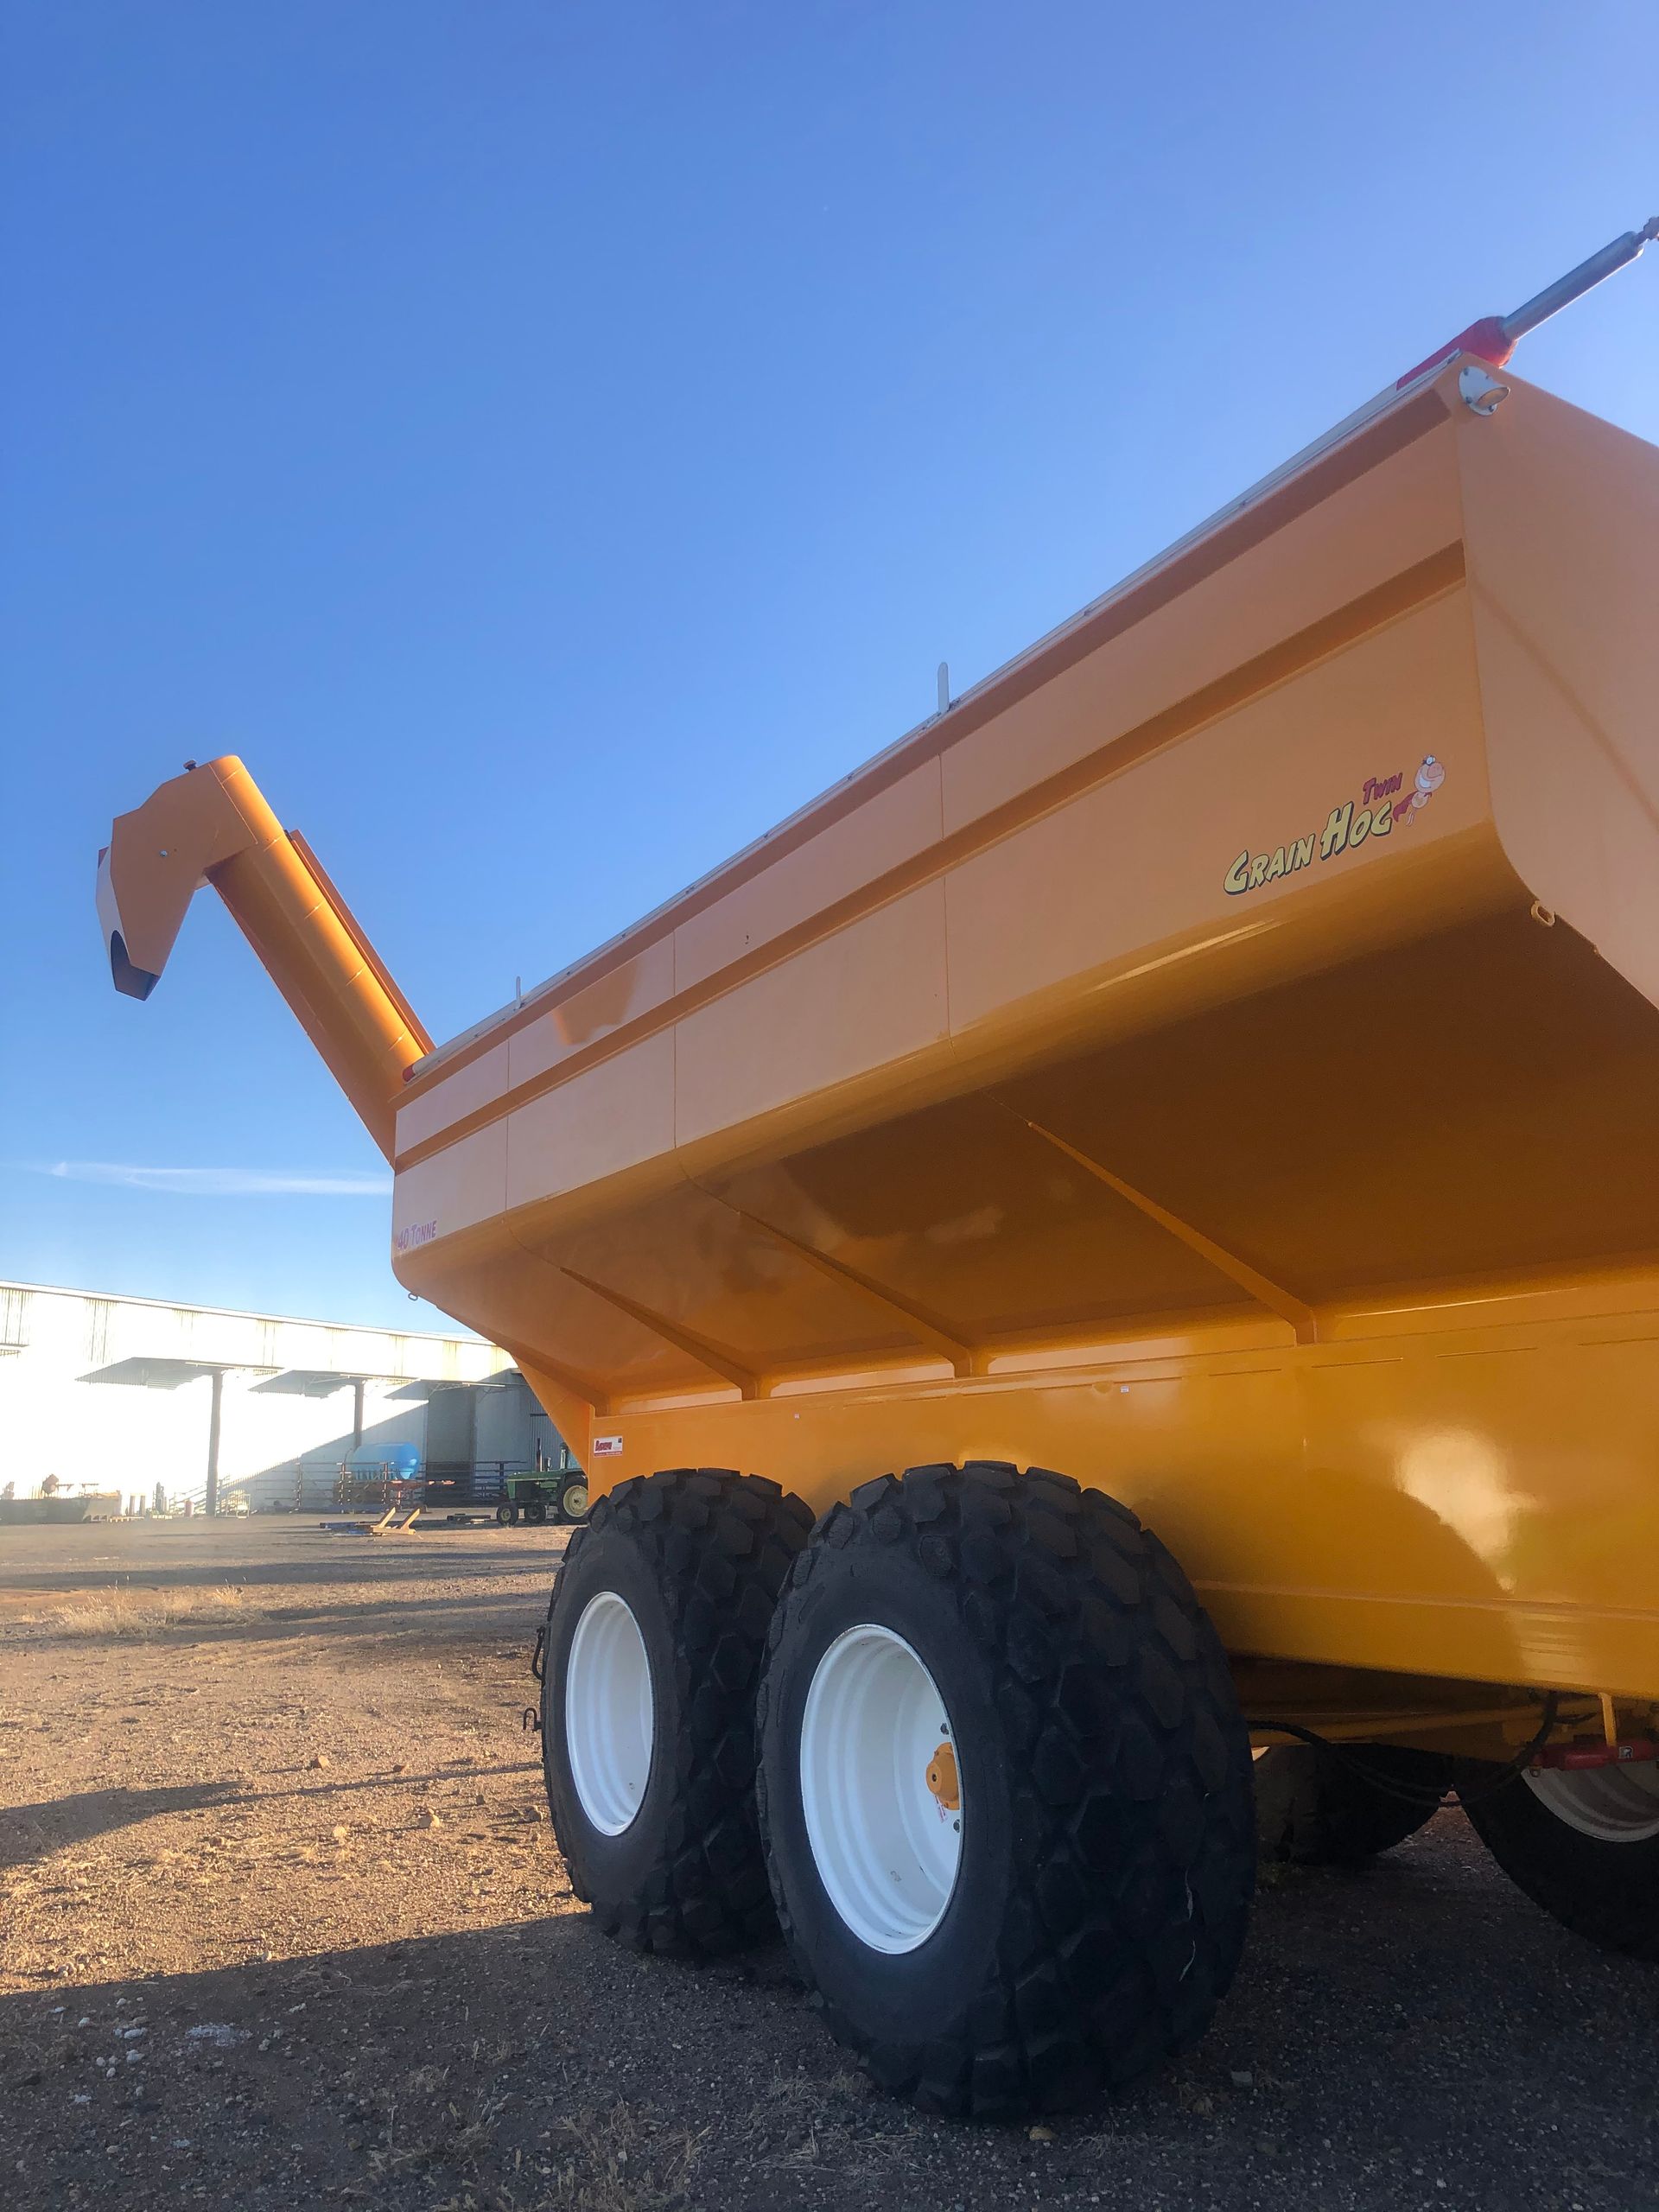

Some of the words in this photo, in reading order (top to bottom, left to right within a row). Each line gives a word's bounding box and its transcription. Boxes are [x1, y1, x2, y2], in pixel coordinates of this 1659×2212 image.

[1363, 772, 1402, 804] TWIN
[1224, 834, 1315, 895] GRAIN
[1320, 801, 1392, 861] HOG
[410, 1219, 437, 1246] TONNE
